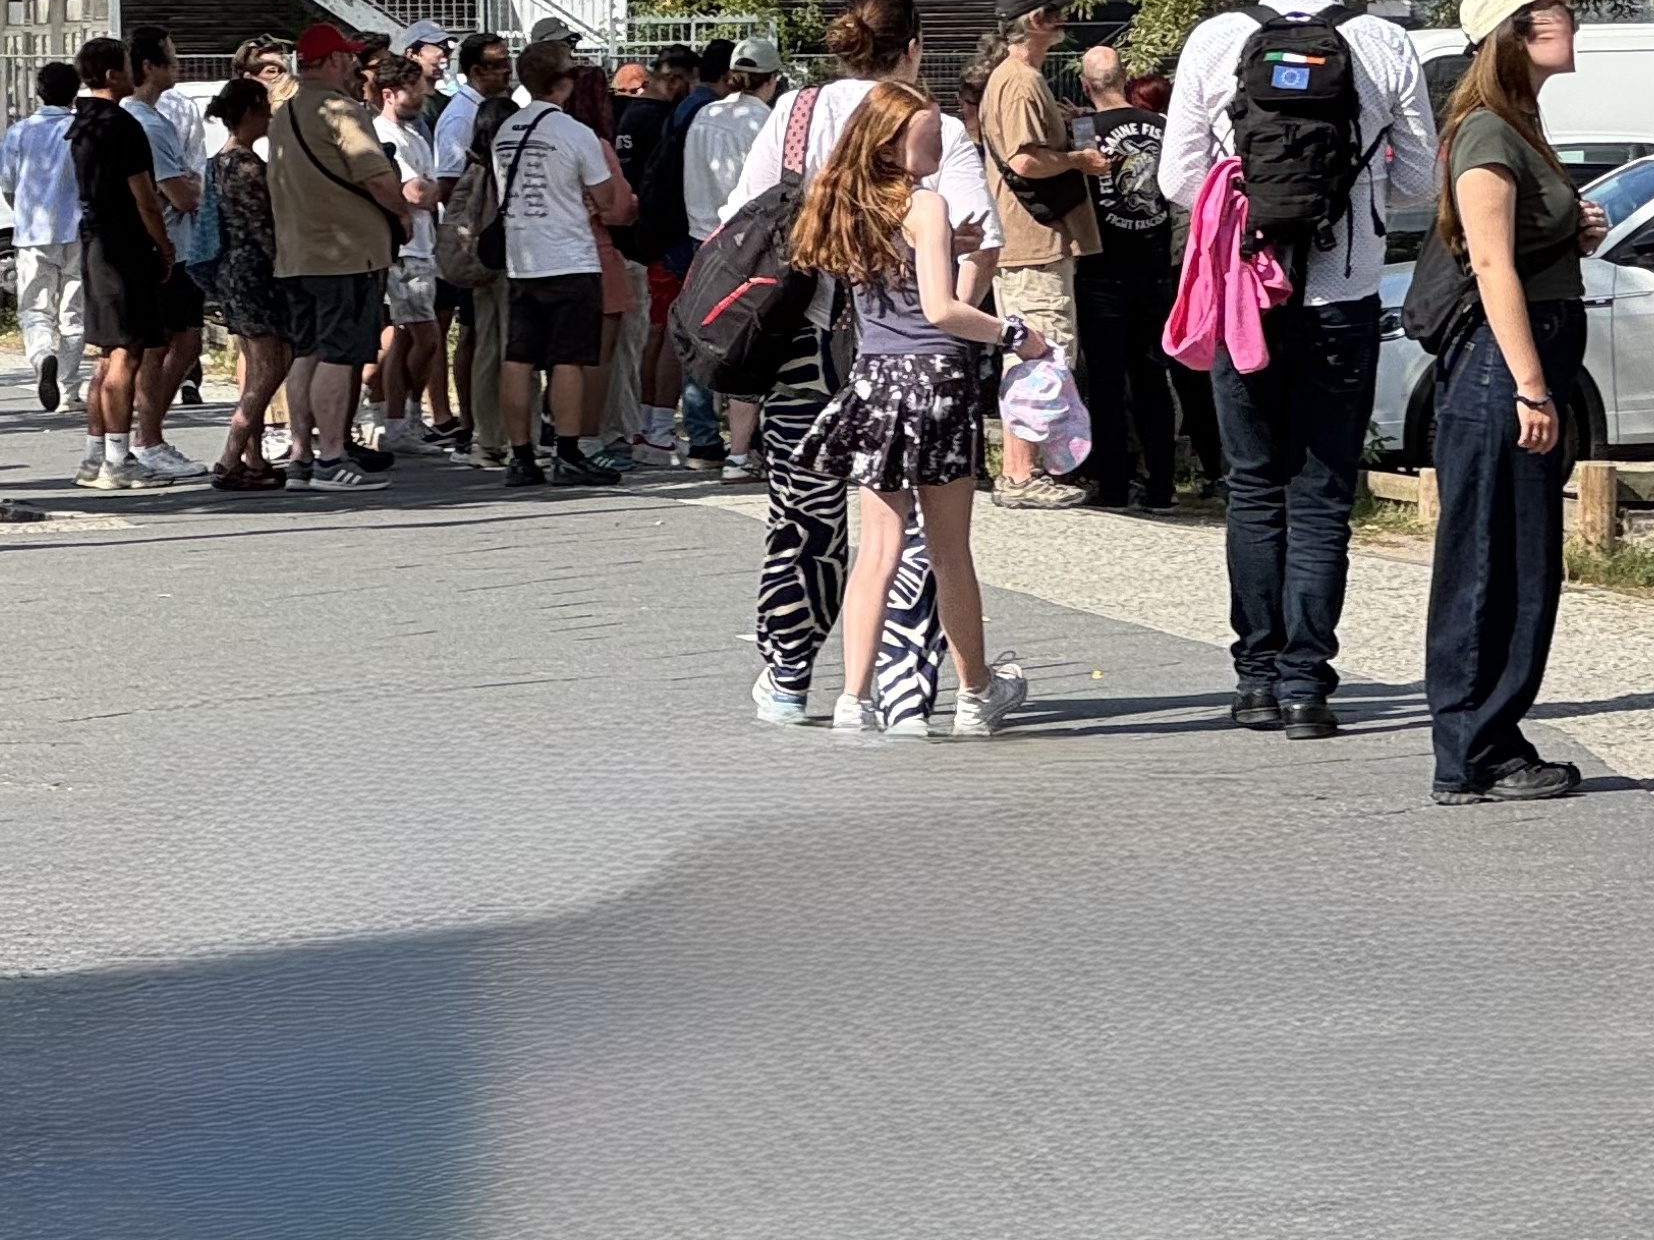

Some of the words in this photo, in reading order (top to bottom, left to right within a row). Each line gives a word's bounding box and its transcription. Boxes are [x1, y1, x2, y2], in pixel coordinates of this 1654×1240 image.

[1101, 123, 1139, 155] SAHNE
[1142, 123, 1163, 140] FIS
[1105, 213, 1133, 230] FIGHT
